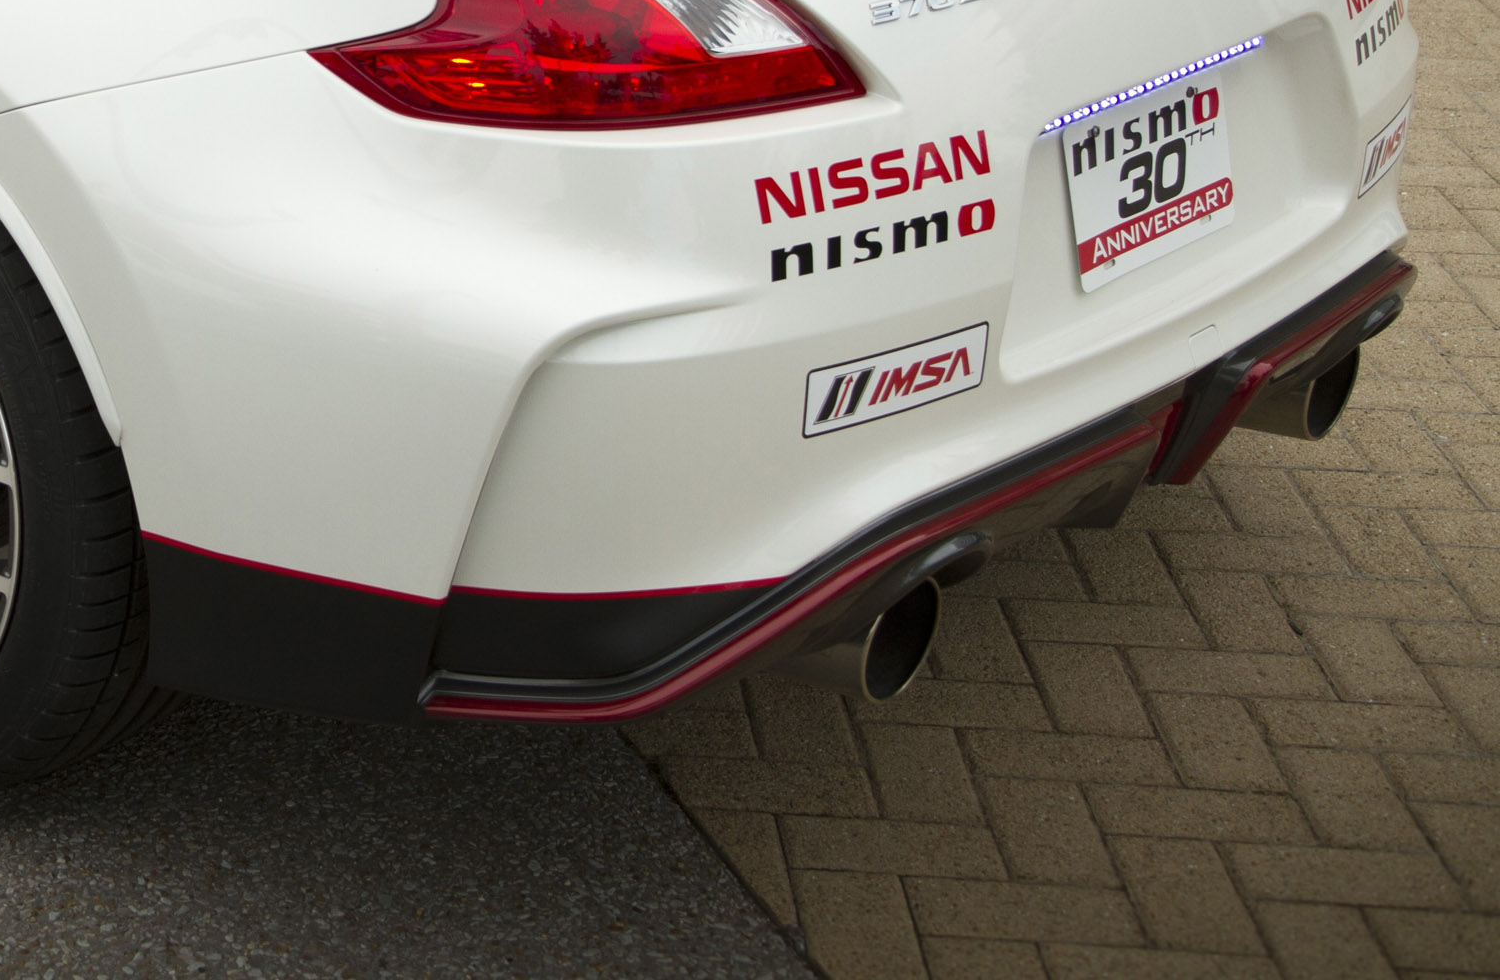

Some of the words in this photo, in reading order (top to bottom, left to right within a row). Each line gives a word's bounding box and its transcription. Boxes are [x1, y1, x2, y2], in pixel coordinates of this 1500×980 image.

[754, 129, 991, 225] NISSAN
[770, 197, 996, 283] nismo
[1091, 182, 1230, 265] ANNIVERSARY
[867, 346, 972, 407] IMSA
